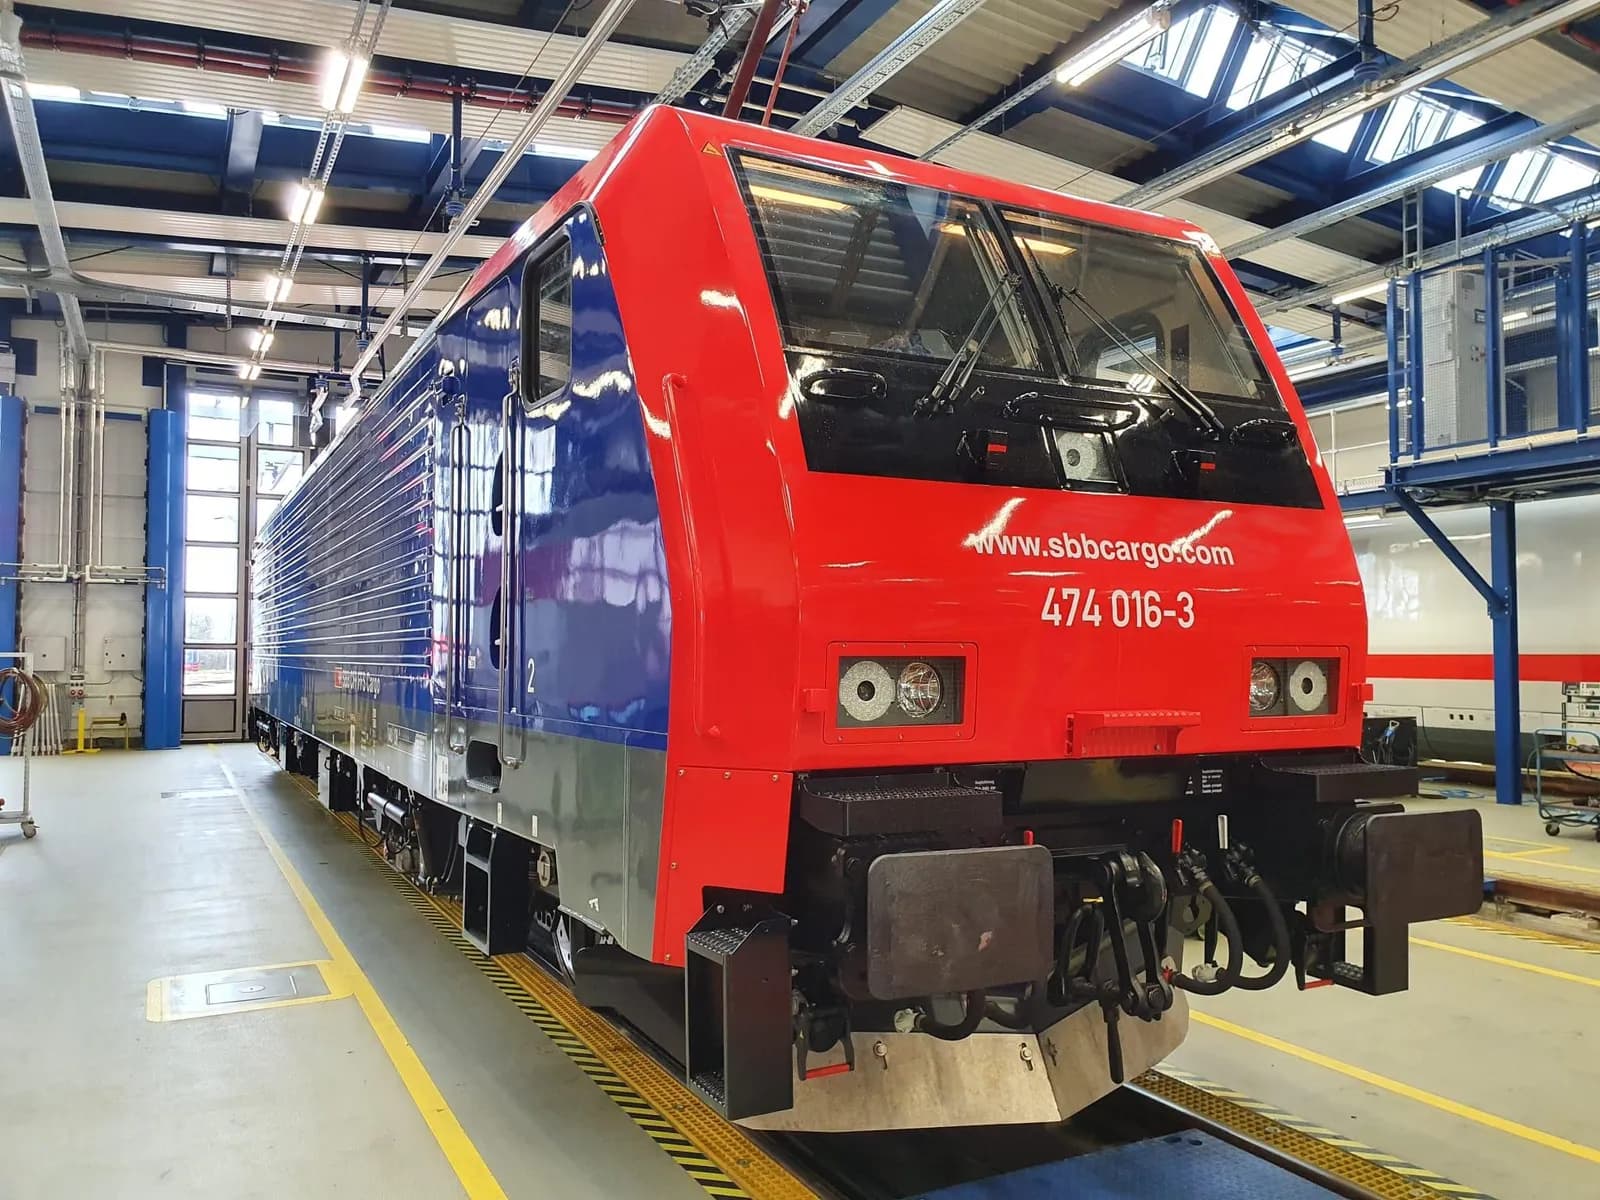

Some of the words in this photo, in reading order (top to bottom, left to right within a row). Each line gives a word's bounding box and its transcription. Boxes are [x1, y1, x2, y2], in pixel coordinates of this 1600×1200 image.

[971, 532, 1235, 569] www.sbbcargo.com
[1041, 587, 1102, 627] 474
[1111, 589, 1195, 629] 016-3
[527, 658, 535, 693] 2
